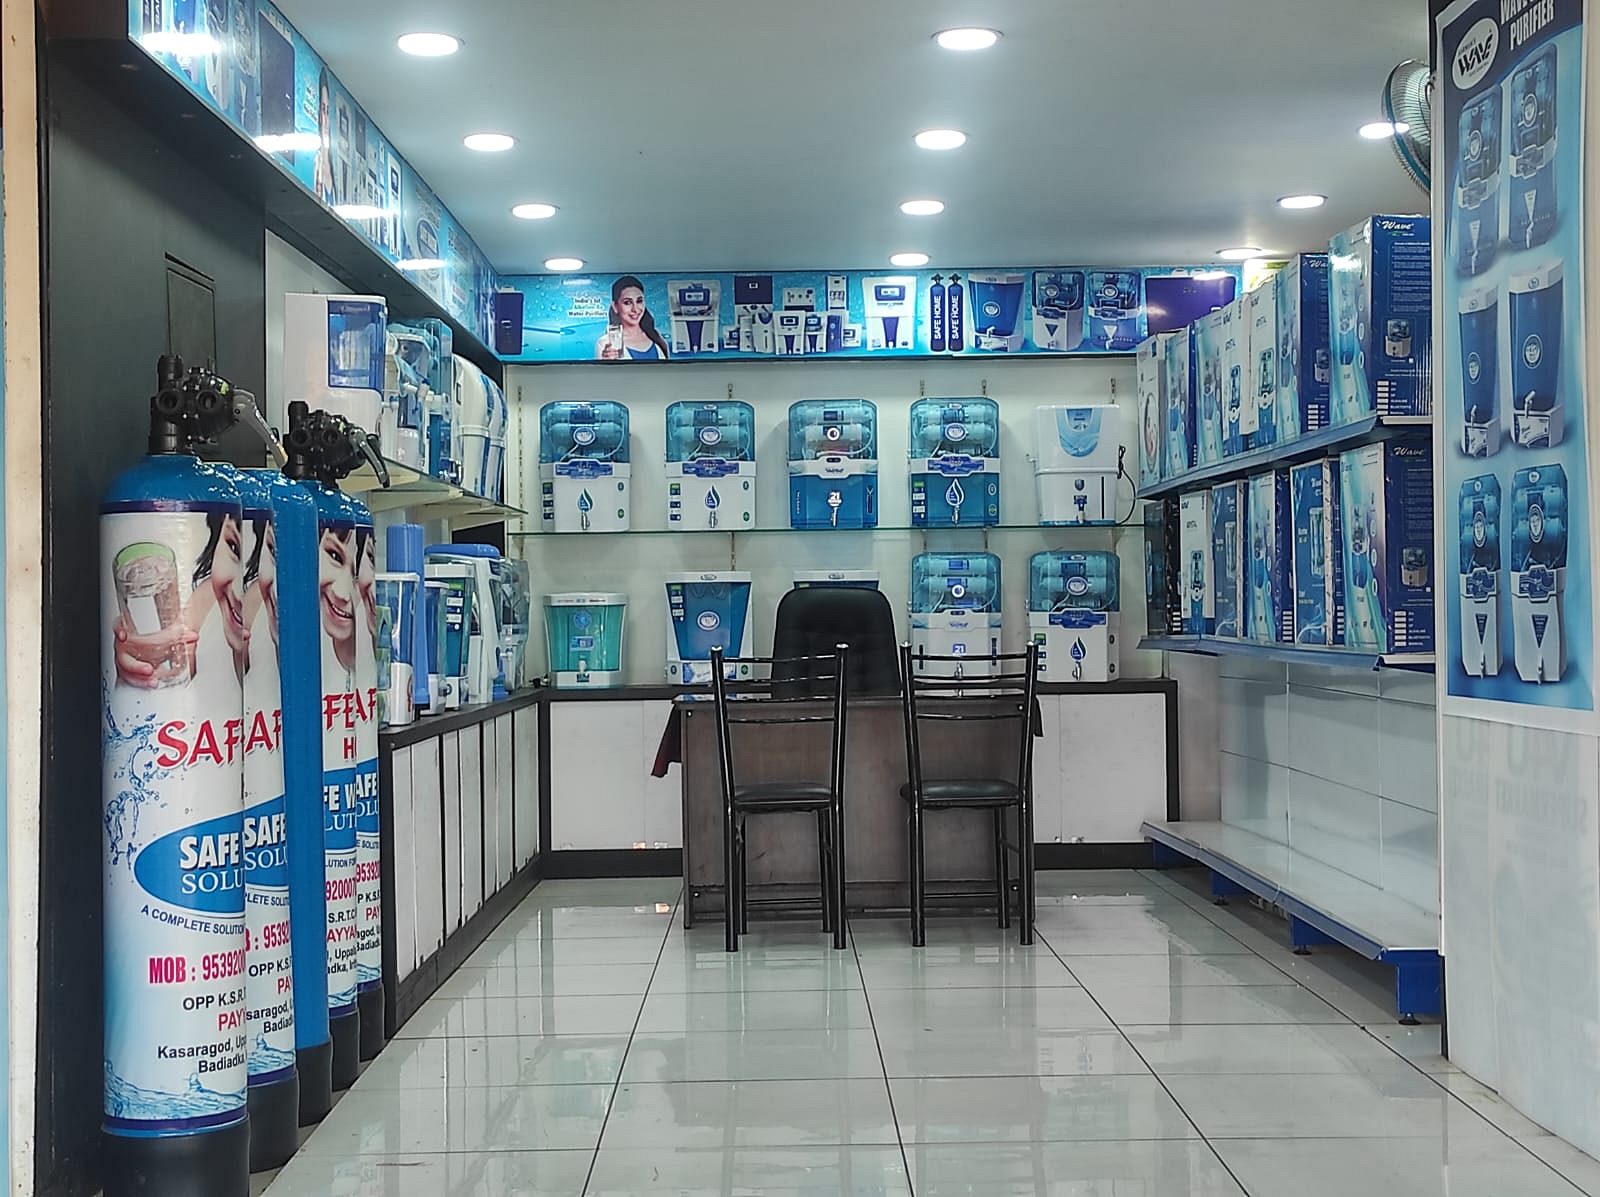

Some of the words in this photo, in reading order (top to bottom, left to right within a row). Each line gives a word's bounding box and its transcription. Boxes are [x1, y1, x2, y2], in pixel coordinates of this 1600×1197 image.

[1500, 0, 1528, 25] WA
[1510, 0, 1554, 51] PURIFIER
[1381, 220, 1414, 230] Wave
[933, 295, 942, 318] HOME
[951, 295, 959, 318] HOME
[934, 319, 942, 340] SAFE
[951, 319, 959, 340] SAFE
[1393, 446, 1425, 457] Wave
[244, 813, 286, 850] SAFE
[180, 832, 240, 870] SAFE
[181, 867, 244, 895] SOLU
[245, 892, 270, 906] LETE
[141, 904, 149, 916] A
[151, 908, 211, 933] COMPLETE
[326, 924, 357, 943] AYYA
[149, 957, 186, 984] MOB
[249, 959, 275, 977] OPP
[183, 994, 215, 1011] OPP
[157, 1038, 234, 1060] Kasaragod,
